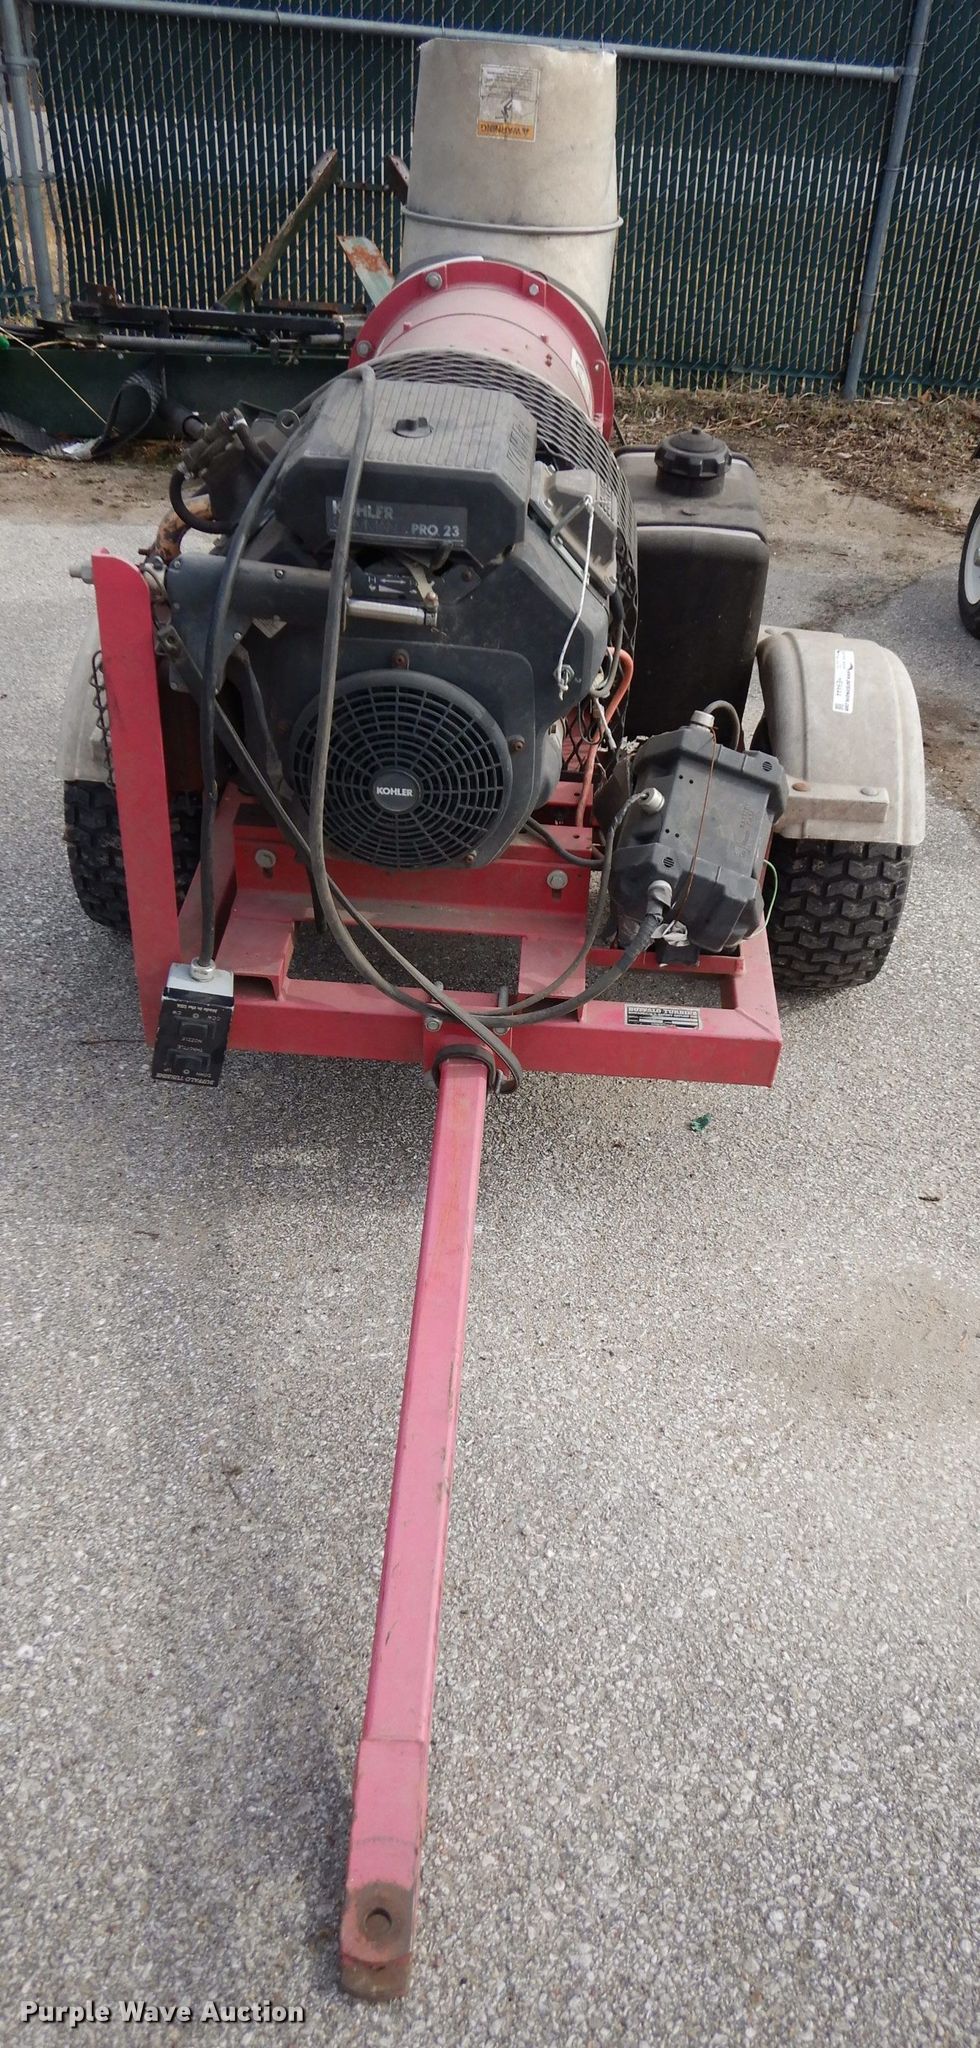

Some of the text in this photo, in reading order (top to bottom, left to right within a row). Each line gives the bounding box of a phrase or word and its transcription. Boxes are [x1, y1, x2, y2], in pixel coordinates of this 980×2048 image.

[480, 123, 521, 136] WARNING
[332, 499, 394, 520] KHLER
[411, 523, 439, 536] PRO
[443, 525, 460, 537] 23
[376, 786, 413, 797] KOHLER
